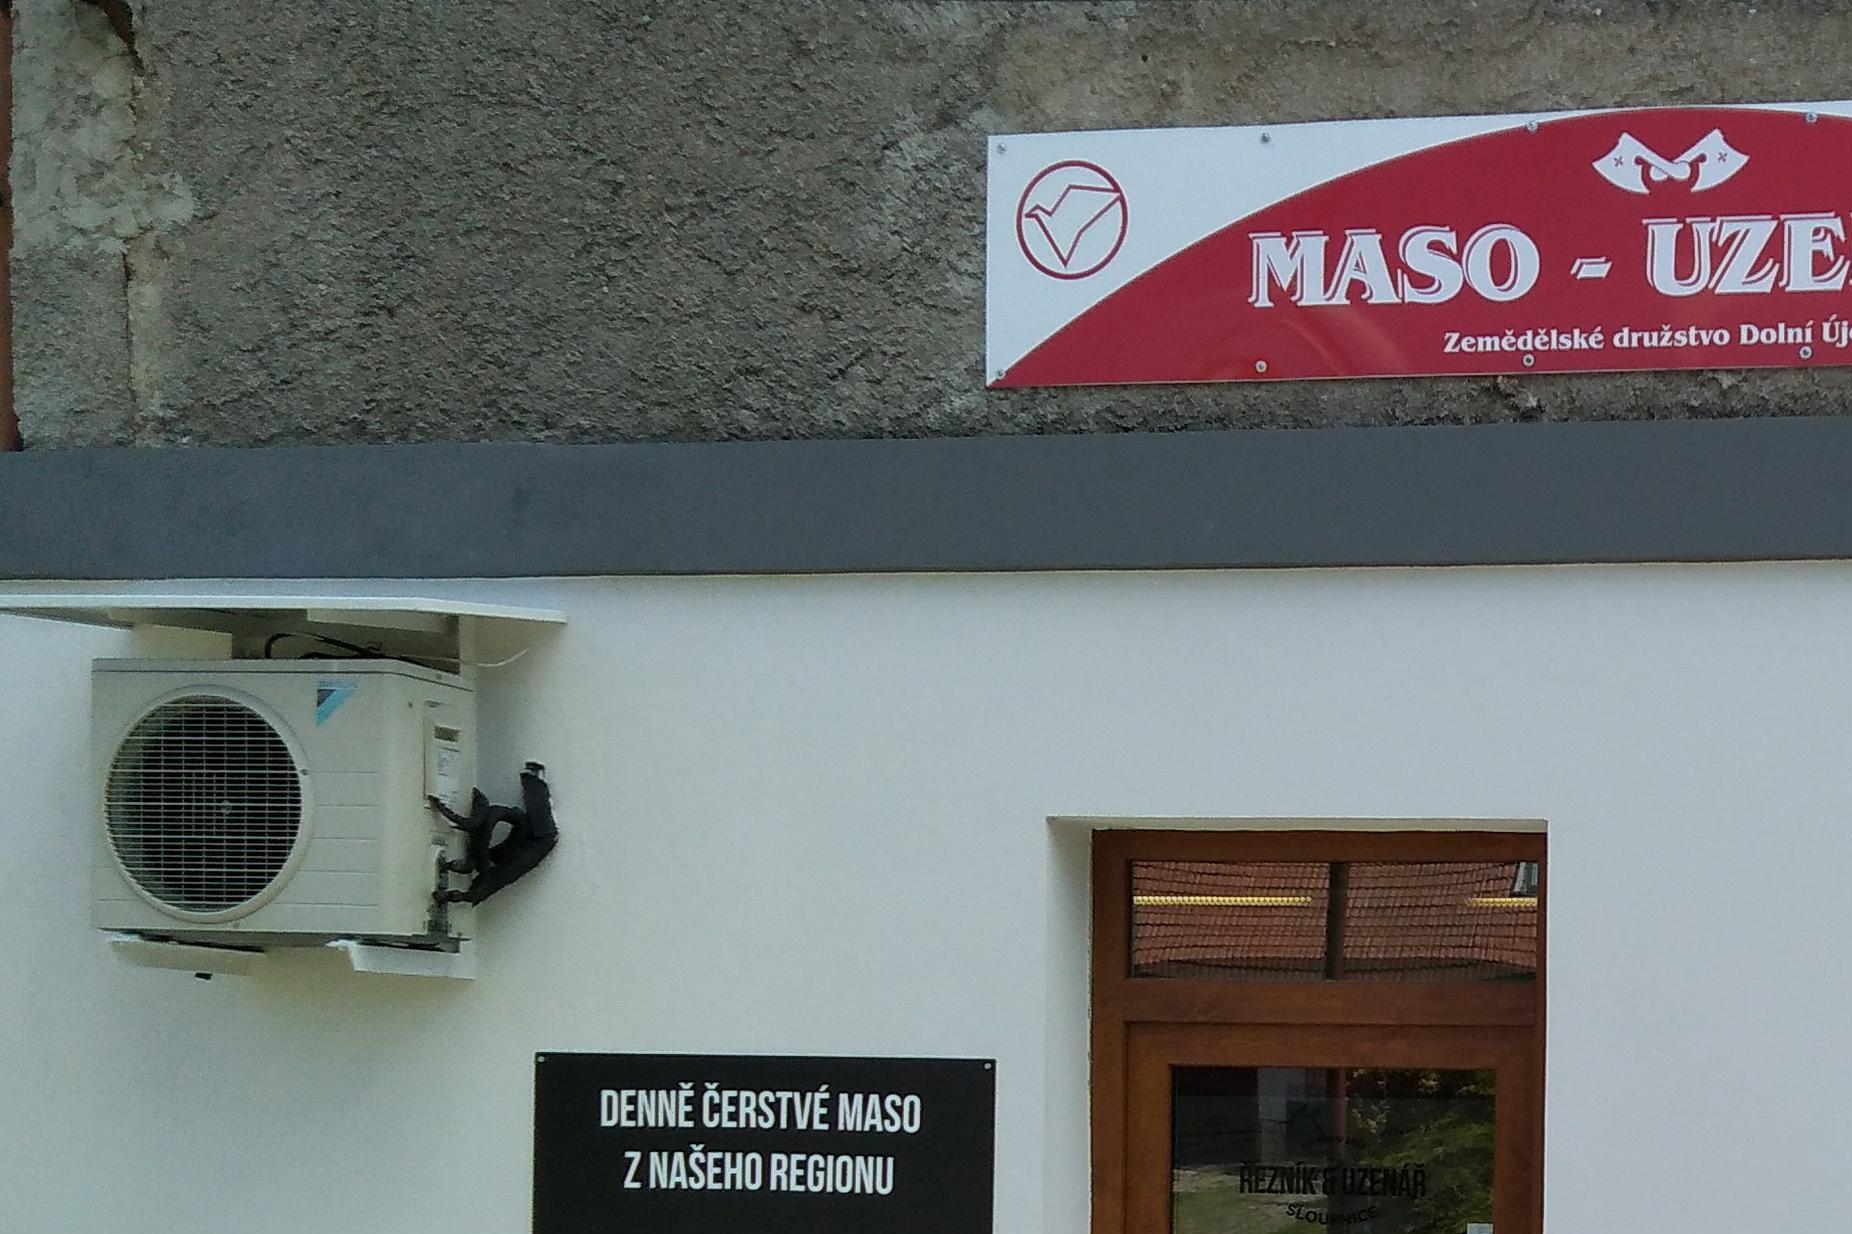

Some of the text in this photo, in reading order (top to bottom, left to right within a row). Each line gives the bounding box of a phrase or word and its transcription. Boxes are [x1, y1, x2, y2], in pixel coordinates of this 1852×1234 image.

[1248, 223, 1540, 307] MASO
[1443, 325, 1605, 353] Zemědělské
[1613, 322, 1731, 350] družstvo
[1739, 318, 1814, 346] Dolní
[600, 1082, 922, 1134] DENNĚ ČERSTVÉ MASO
[623, 1144, 896, 1196] Z NAŠEHO REGIONU
[1286, 1202, 1379, 1226] SLOUPNICE
